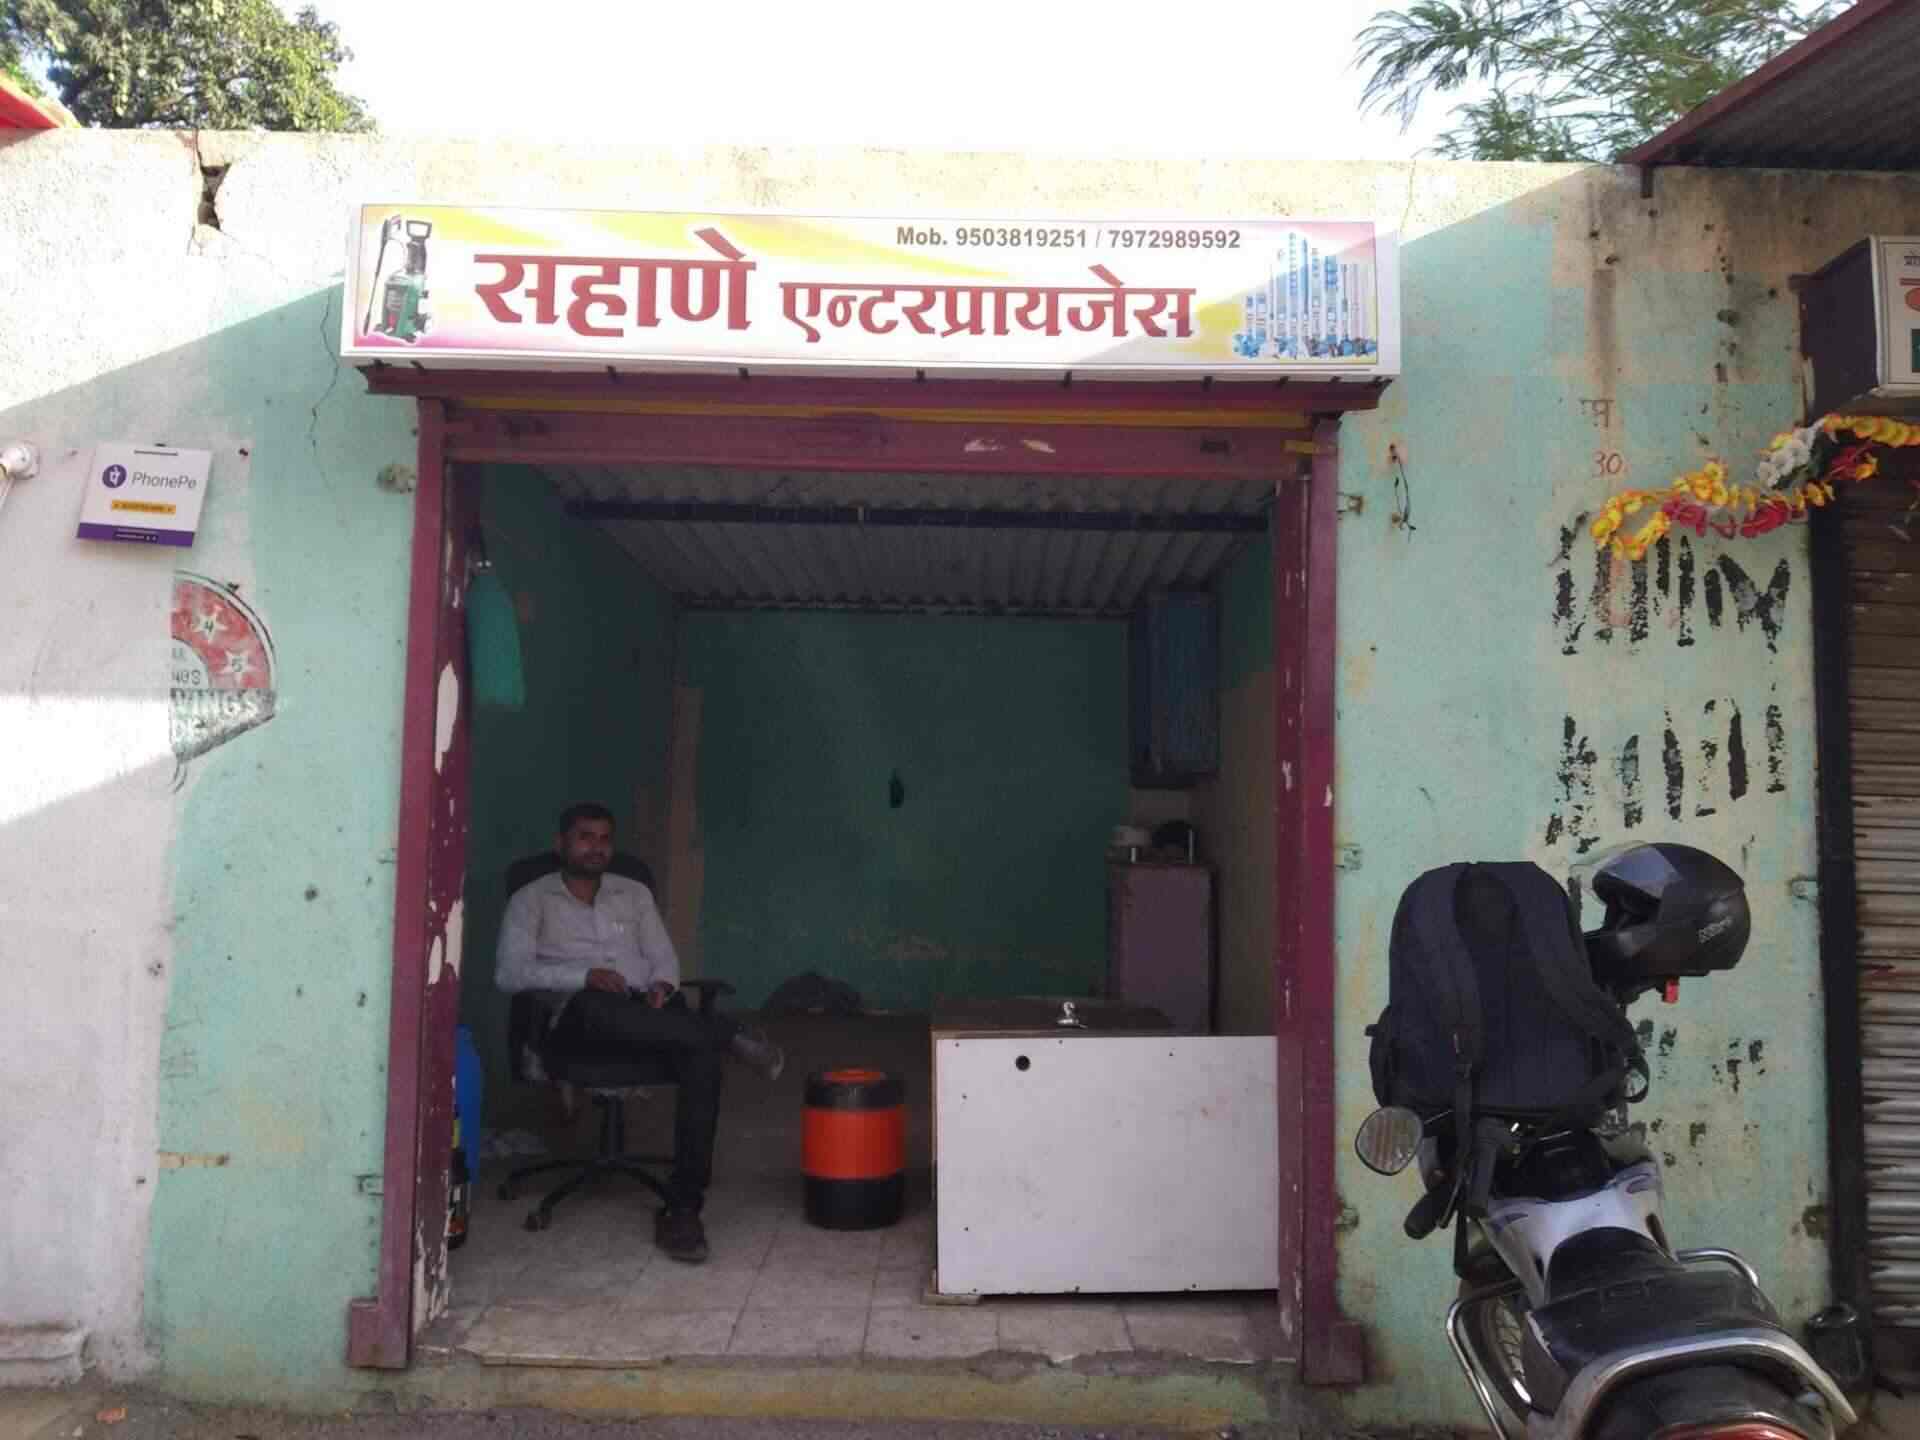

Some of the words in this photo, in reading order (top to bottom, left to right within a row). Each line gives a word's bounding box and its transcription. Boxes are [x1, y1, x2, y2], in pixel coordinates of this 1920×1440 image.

[896, 226, 948, 246] Mob.
[955, 227, 1087, 248] 9503819251
[1108, 229, 1242, 249] 7972989592
[474, 227, 757, 338] सहाणे
[778, 263, 1197, 343] एन्टरप्रायजेस
[131, 471, 198, 490] PhonePe
